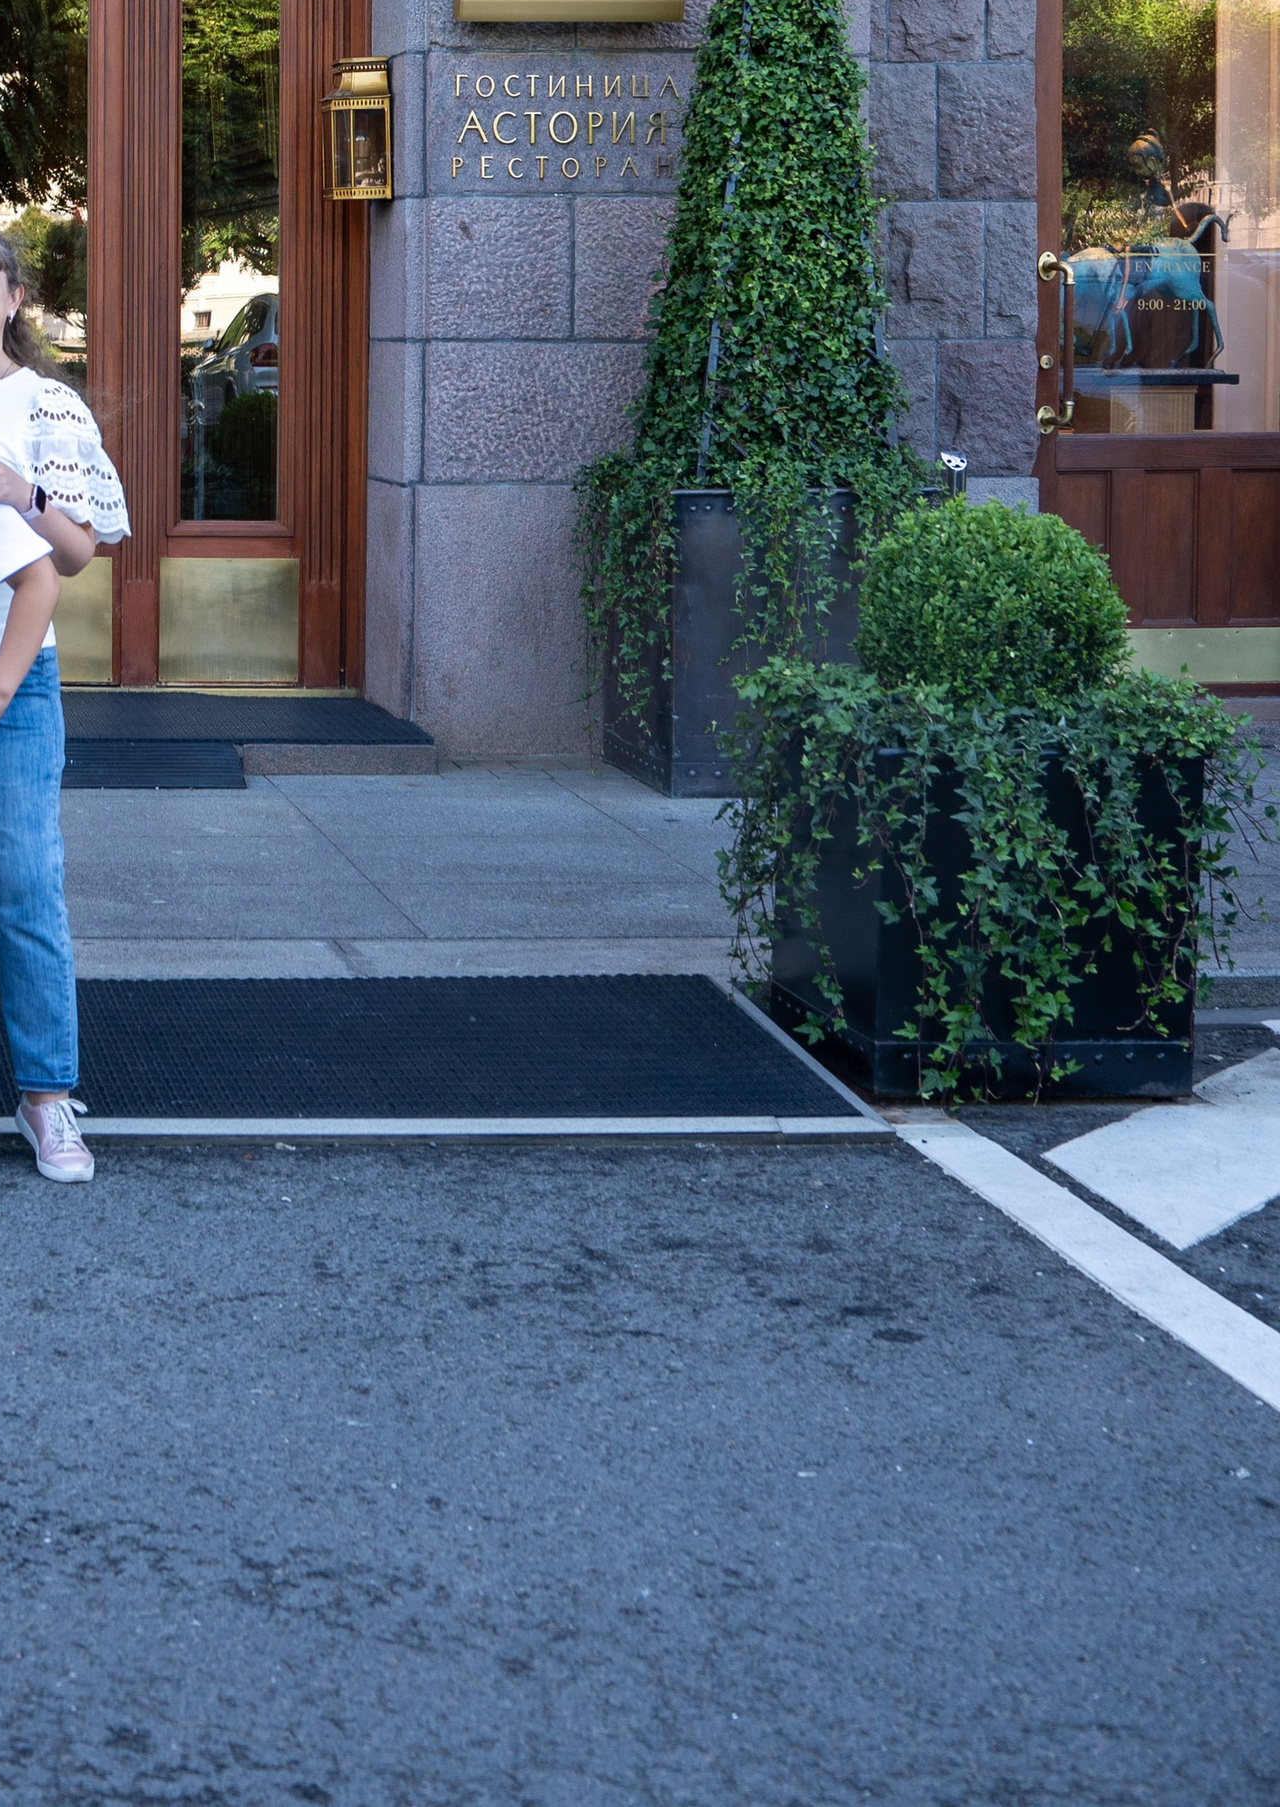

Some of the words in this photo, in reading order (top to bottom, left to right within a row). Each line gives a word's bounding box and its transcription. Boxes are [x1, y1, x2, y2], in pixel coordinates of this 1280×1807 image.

[454, 74, 680, 98] ГОСТИНИЦА
[457, 109, 667, 145] АСТОРИЯ
[451, 154, 674, 179] РЕСТОРАН
[1134, 261, 1211, 273] ENTRANCE
[1137, 298, 1164, 311] 9:00
[1173, 298, 1207, 311] 21:00
